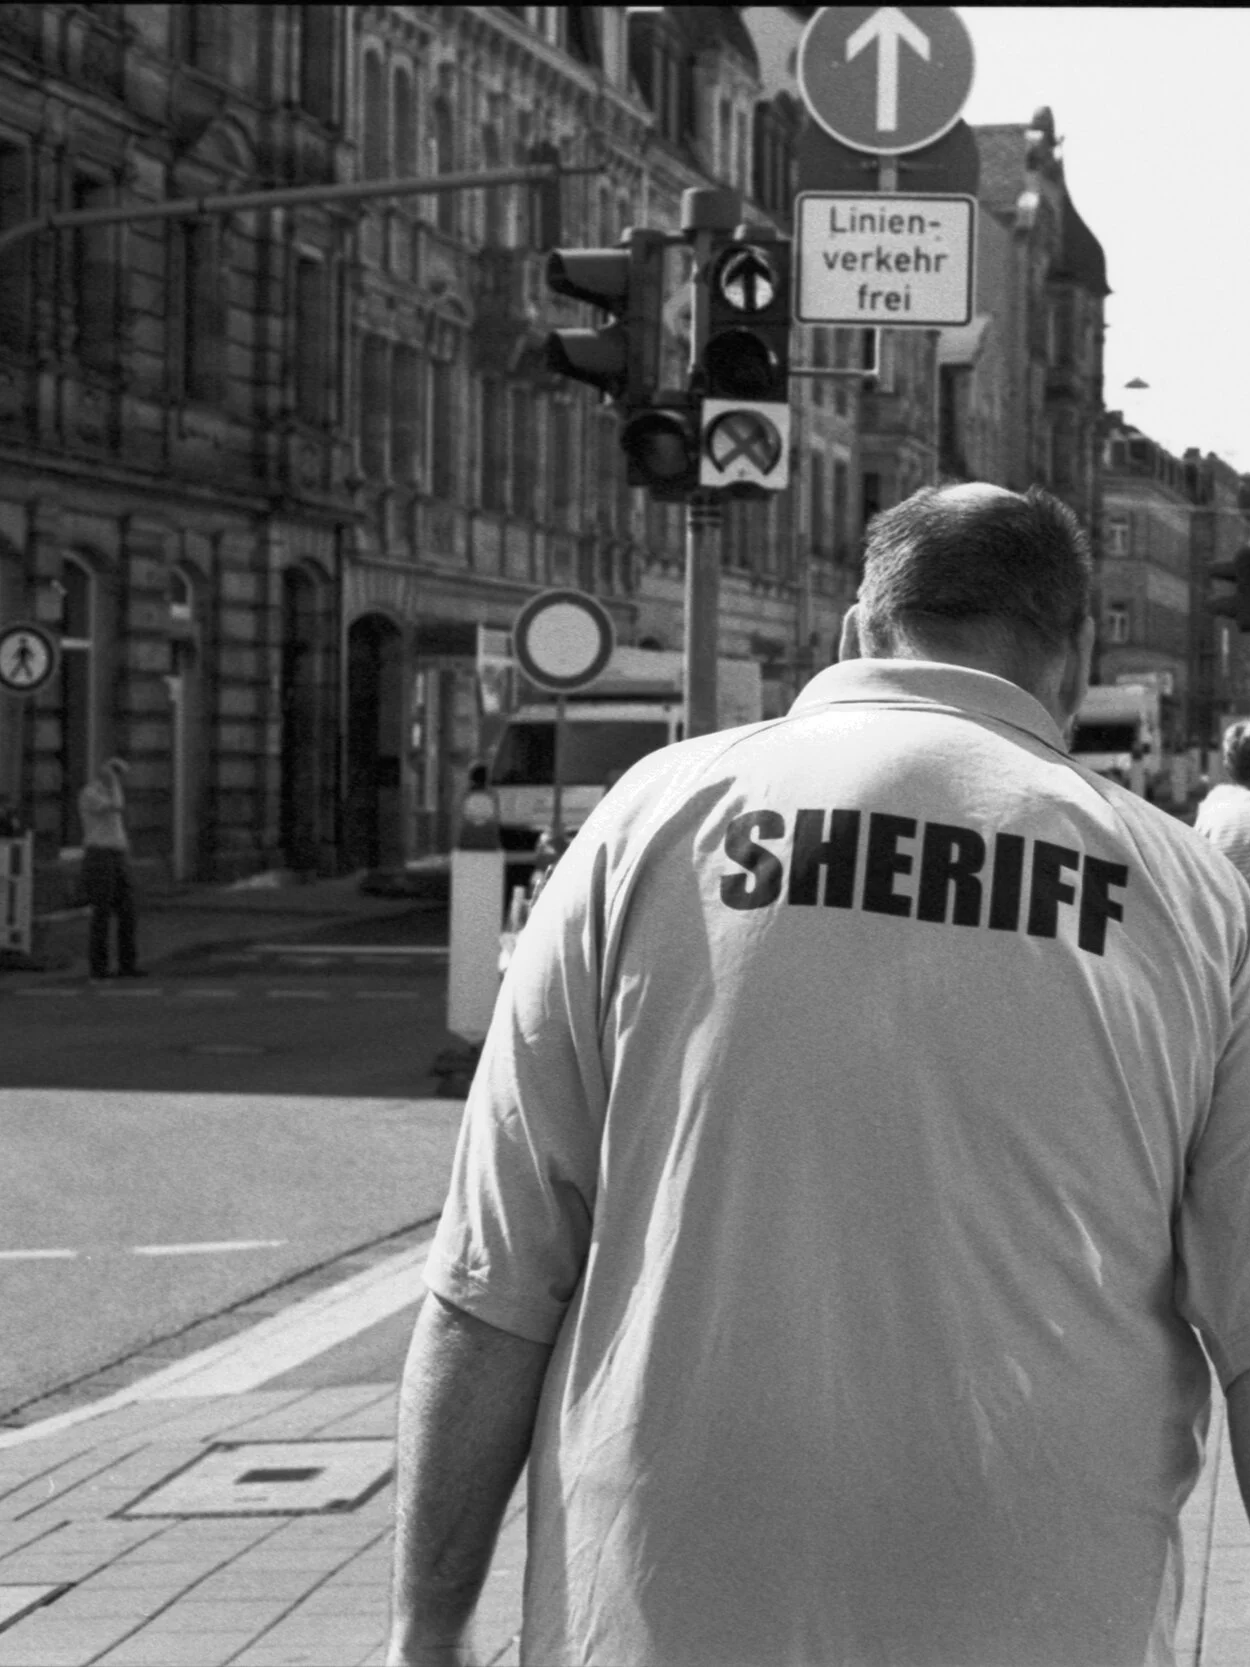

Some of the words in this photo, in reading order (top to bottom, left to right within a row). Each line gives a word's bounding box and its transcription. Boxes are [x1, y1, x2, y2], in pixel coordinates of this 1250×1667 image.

[829, 205, 942, 235] Linien-
[822, 245, 948, 273] verkehr
[858, 283, 911, 311] frei
[719, 808, 1129, 957] SHERIFF
